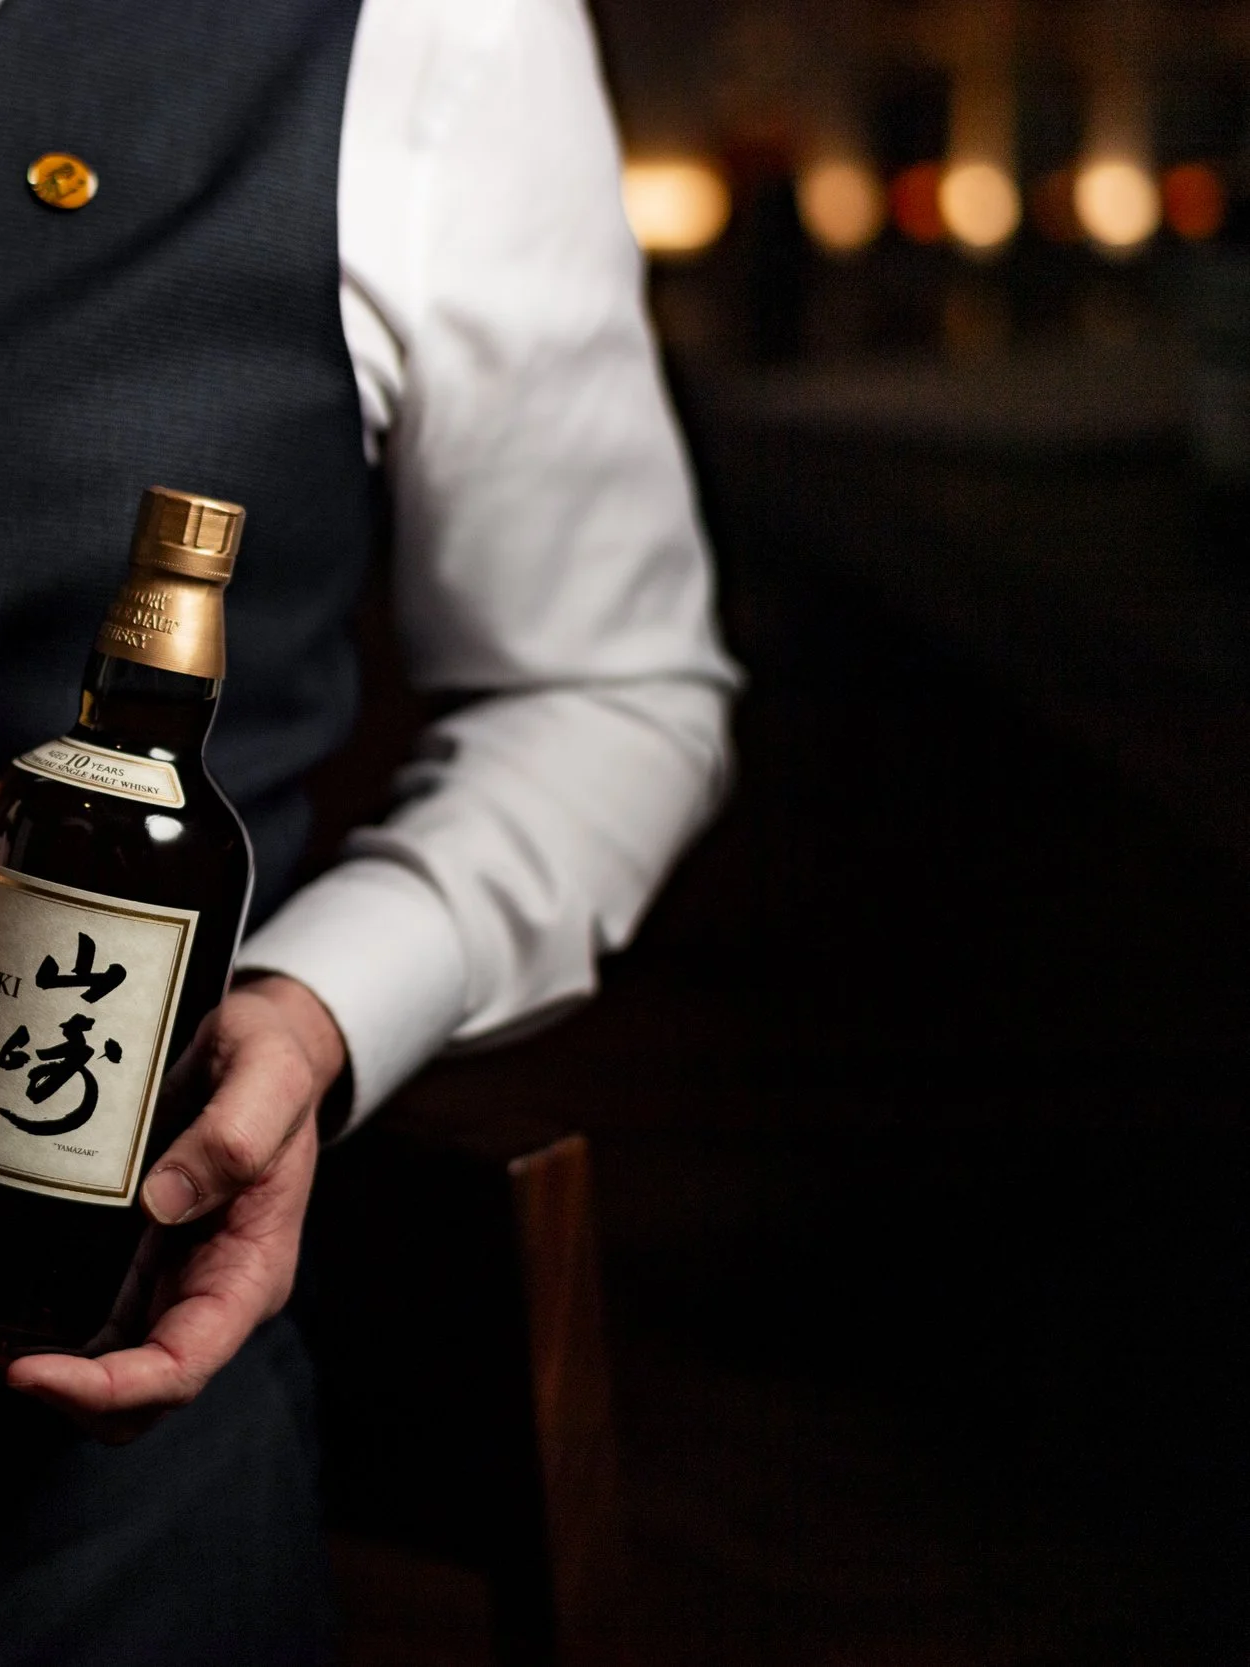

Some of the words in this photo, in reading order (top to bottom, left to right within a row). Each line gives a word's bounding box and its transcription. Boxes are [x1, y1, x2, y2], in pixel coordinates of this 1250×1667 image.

[133, 609, 179, 635] MALT
[48, 749, 69, 761] AGED
[65, 752, 91, 769] 10
[92, 762, 125, 777] YEARS
[57, 765, 87, 778] SINGLE
[90, 773, 119, 786] MALT
[120, 780, 160, 794] WHISKY
[53, 1142, 100, 1157] "YAMAZAKI"
